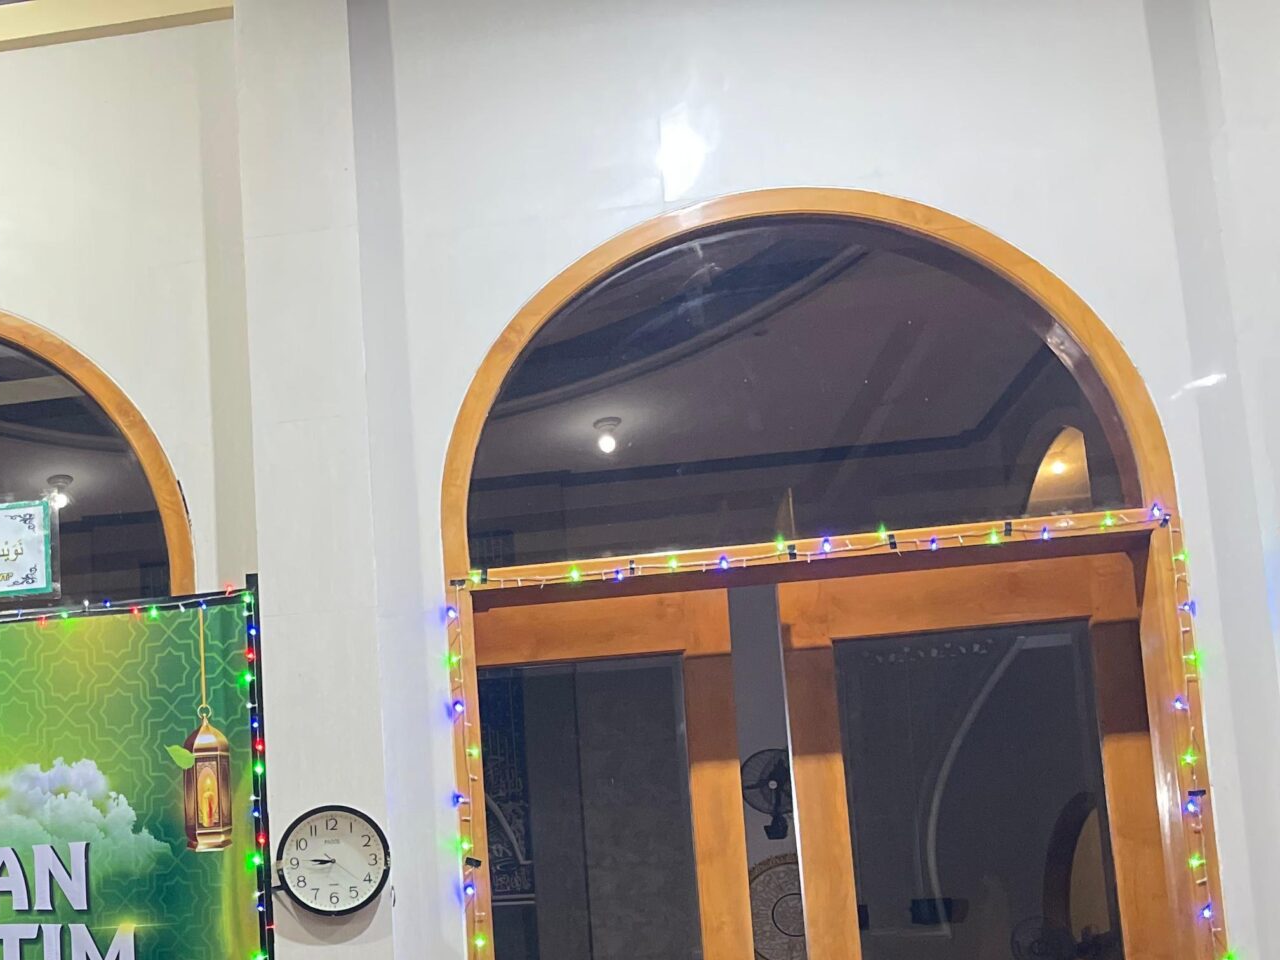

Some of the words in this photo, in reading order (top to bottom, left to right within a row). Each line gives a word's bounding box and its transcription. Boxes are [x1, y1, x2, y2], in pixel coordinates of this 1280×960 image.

[310, 824, 317, 837] 11
[325, 817, 338, 831] 12
[349, 822, 353, 834] 1
[295, 837, 308, 851] 10
[361, 834, 371, 848] 2
[289, 857, 300, 870] 9
[367, 853, 378, 866] 3
[296, 875, 307, 888] 8
[363, 872, 372, 884] 4
[311, 888, 320, 901] 7
[329, 891, 340, 905] 6
[349, 886, 359, 899] 5
